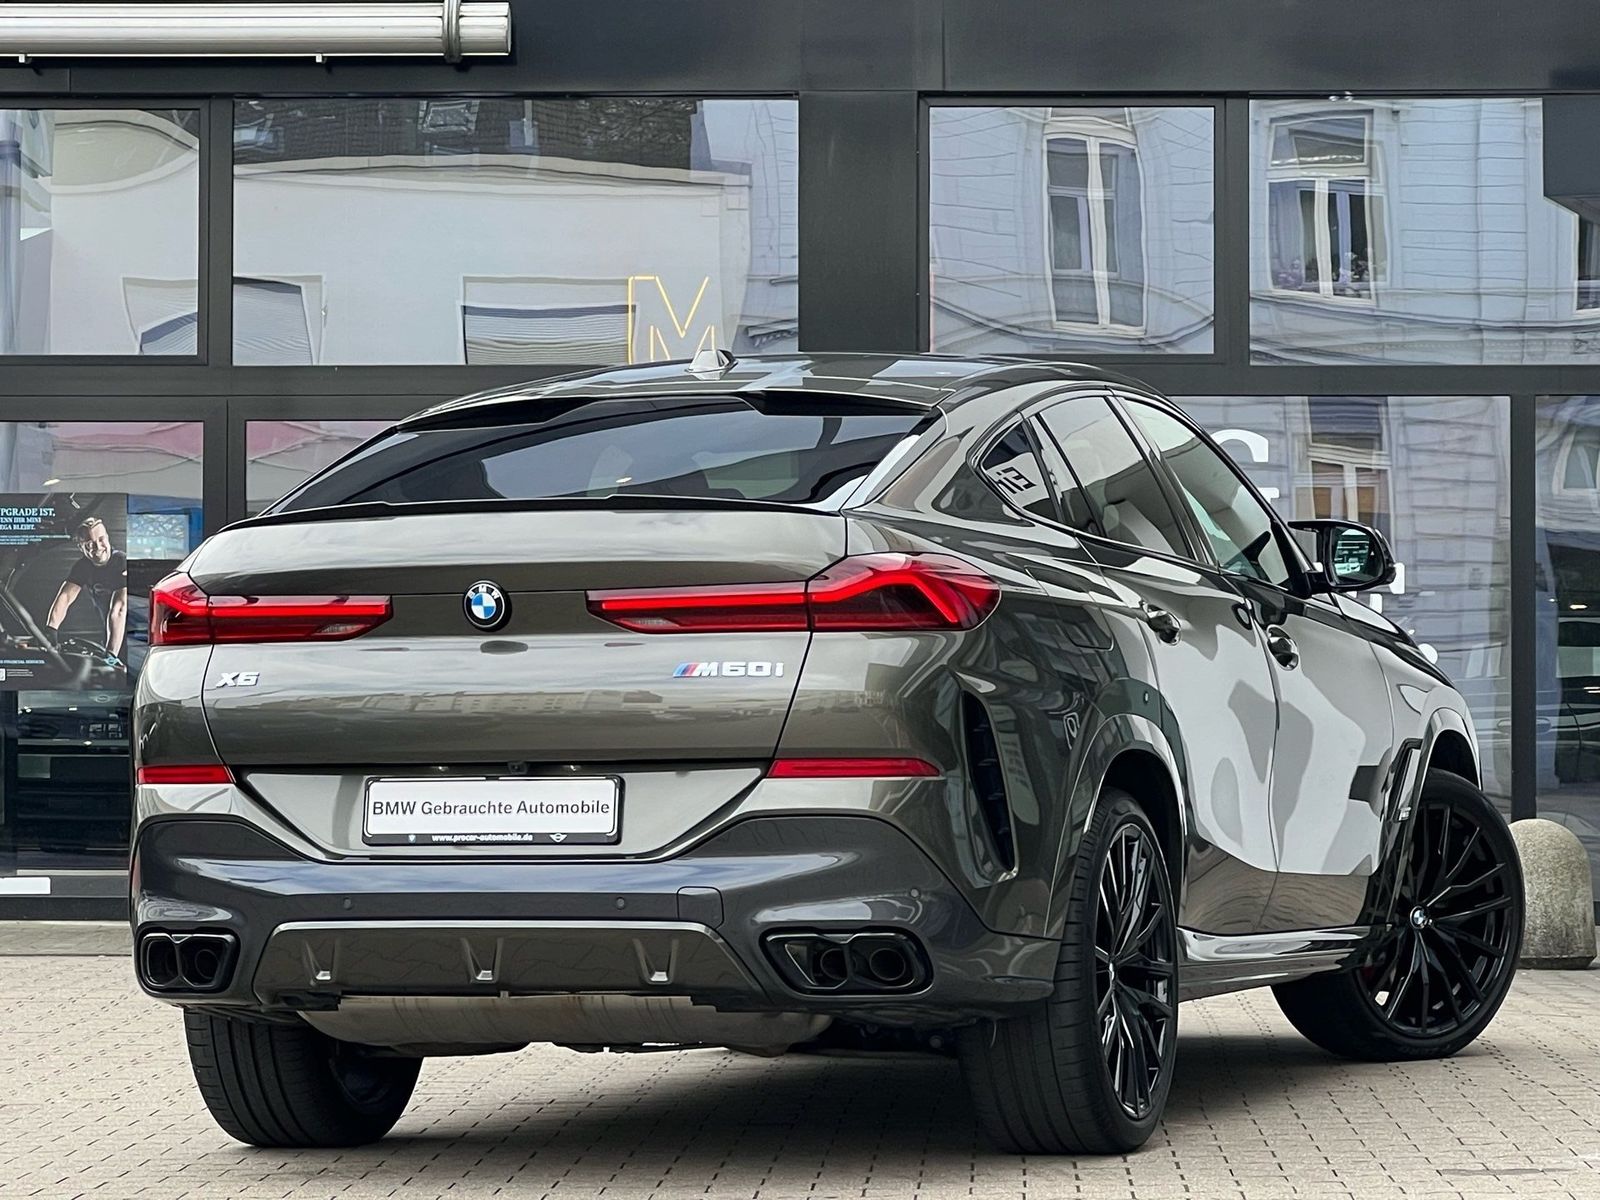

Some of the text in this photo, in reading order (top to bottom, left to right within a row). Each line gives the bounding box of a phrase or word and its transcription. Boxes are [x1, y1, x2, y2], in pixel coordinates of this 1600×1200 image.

[0, 508, 38, 517] PGRADE
[215, 671, 260, 689] X6
[372, 800, 610, 815] BMW Gebrauchte Automobile
[431, 833, 534, 843] www.procar-automobile.de
